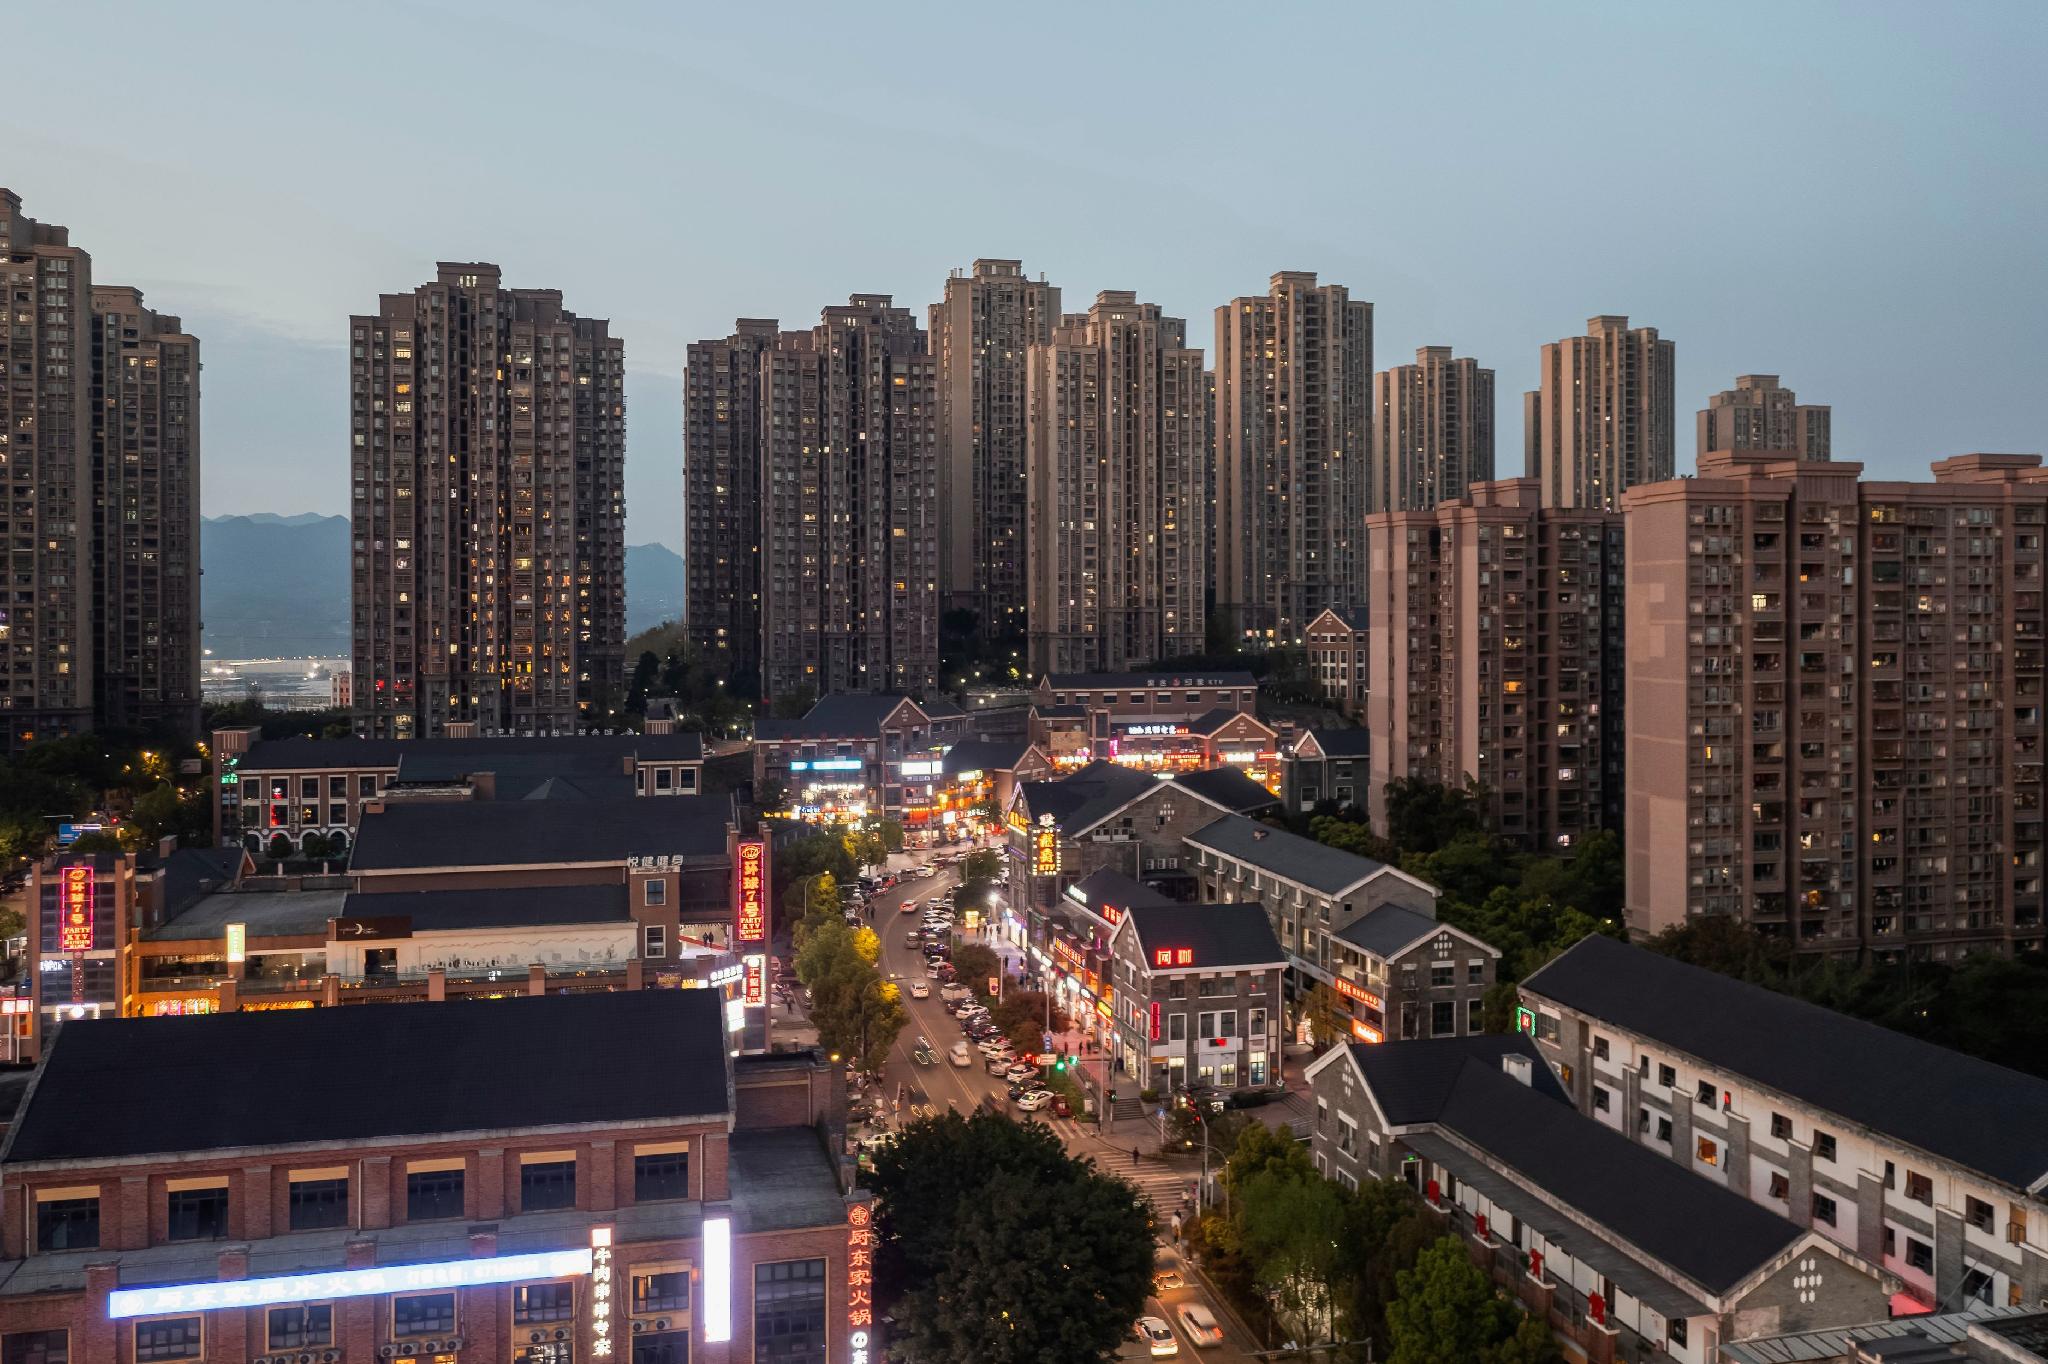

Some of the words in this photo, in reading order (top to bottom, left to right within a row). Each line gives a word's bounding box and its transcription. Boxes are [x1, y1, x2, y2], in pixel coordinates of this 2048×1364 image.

[743, 860, 760, 917] 环球7号
[592, 1247, 611, 1356] 牛肉串串专家
[848, 1229, 872, 1326] 厨东家火锅
